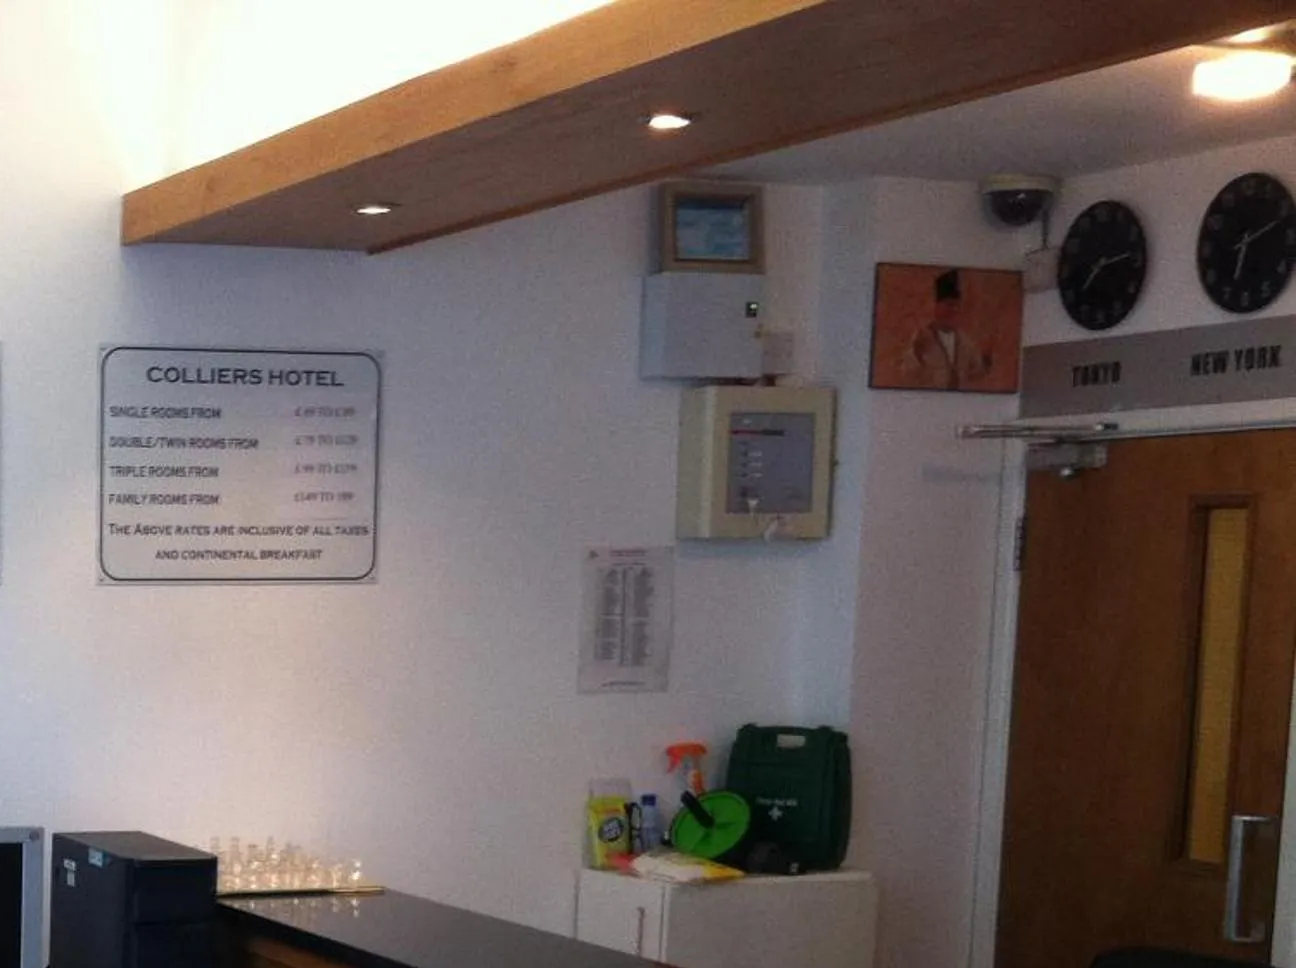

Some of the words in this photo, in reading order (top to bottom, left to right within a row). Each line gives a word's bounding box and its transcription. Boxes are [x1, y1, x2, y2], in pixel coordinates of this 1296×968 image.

[1189, 350, 1231, 377] NEW
[1234, 344, 1283, 372] YORK
[146, 366, 262, 385] COLLIERS
[267, 369, 345, 387] HOTEL
[108, 406, 149, 418] SINGLE
[151, 406, 189, 419] ROOMS
[108, 465, 147, 478] TRIPLE
[107, 493, 148, 505] FAMILY
[133, 523, 173, 536] ABOVE
[174, 525, 211, 536] RATES
[212, 525, 235, 536] ARE
[237, 525, 295, 537] INCLUSIVE
[312, 525, 333, 537] ALL
[155, 550, 180, 560] AND
[181, 549, 258, 561] CONTINENTAL
[259, 549, 323, 561] BREAKFAST
